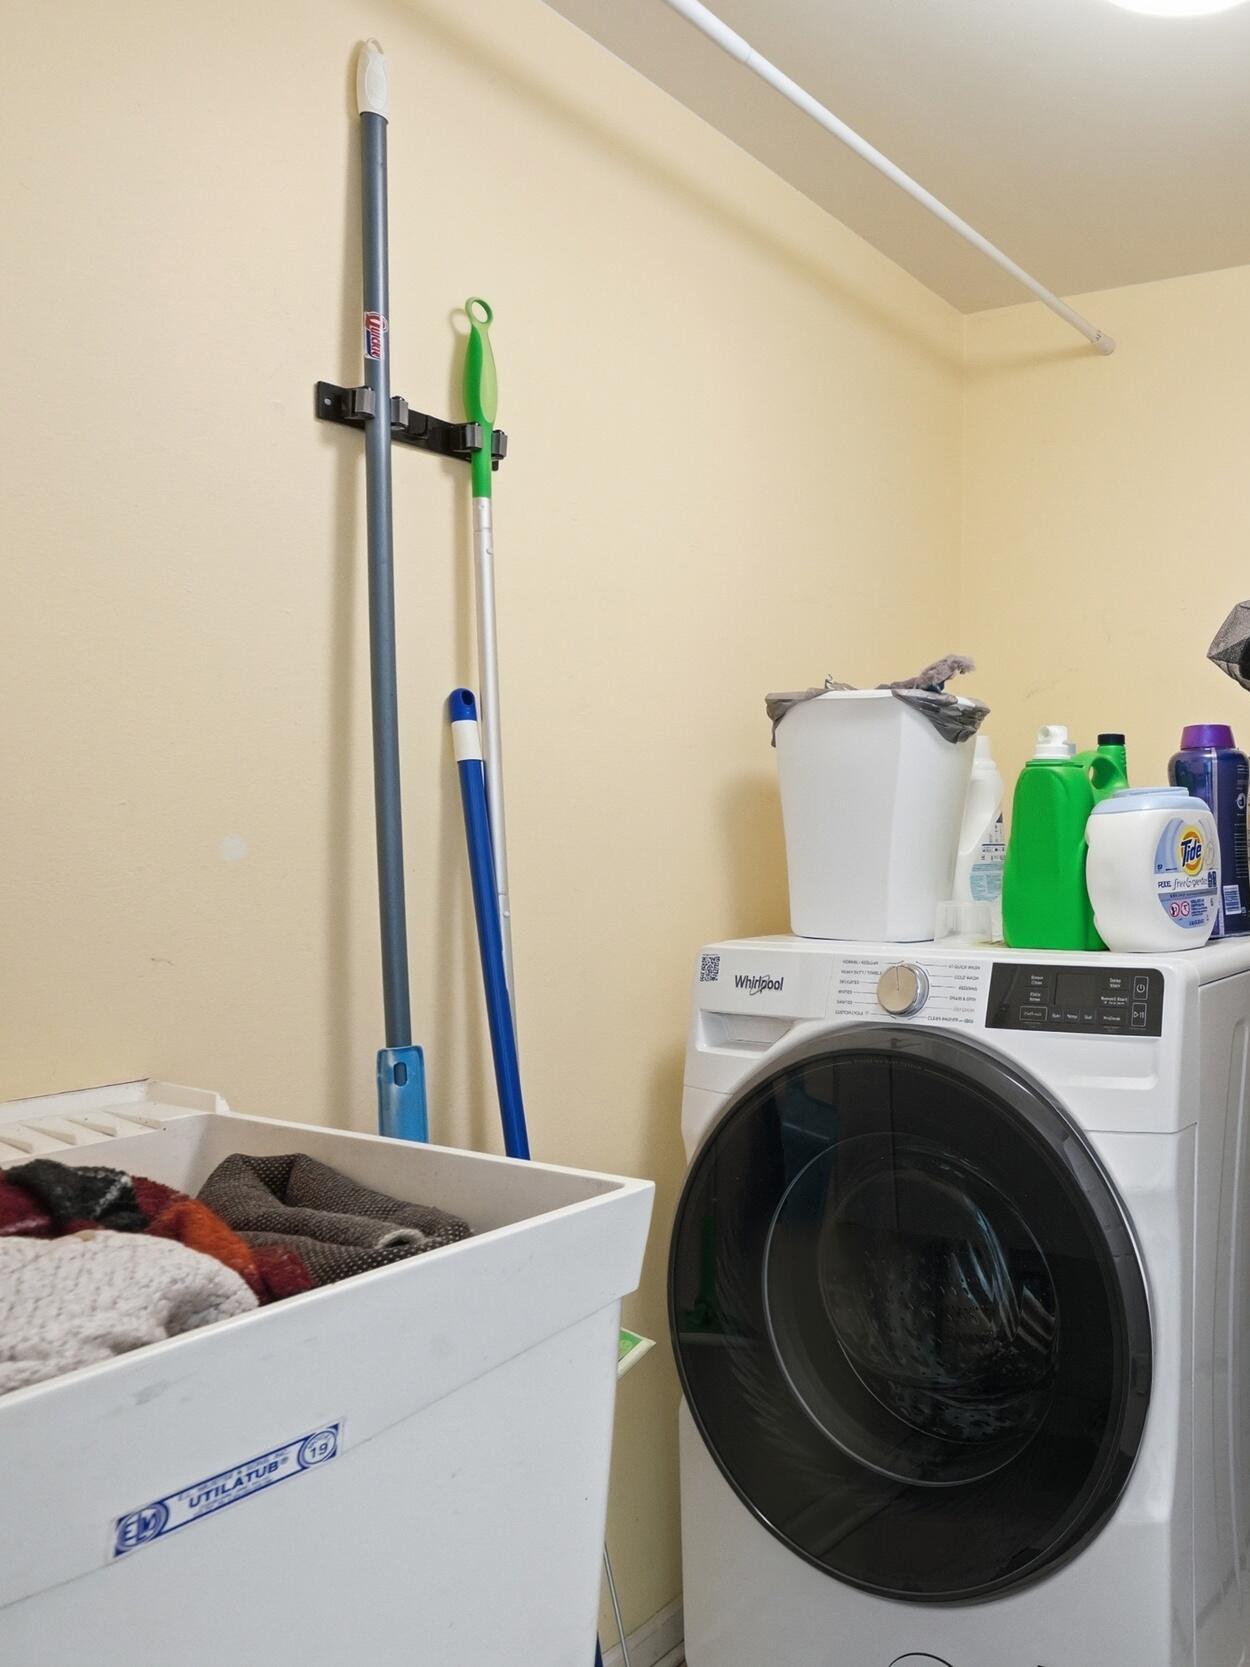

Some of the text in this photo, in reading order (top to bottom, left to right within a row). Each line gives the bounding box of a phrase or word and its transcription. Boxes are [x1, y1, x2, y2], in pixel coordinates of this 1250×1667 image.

[1180, 836, 1203, 867] Tide
[734, 974, 785, 994] Whirlpool
[310, 1442, 329, 1459] 19
[188, 1460, 279, 1508] UTILATUB
